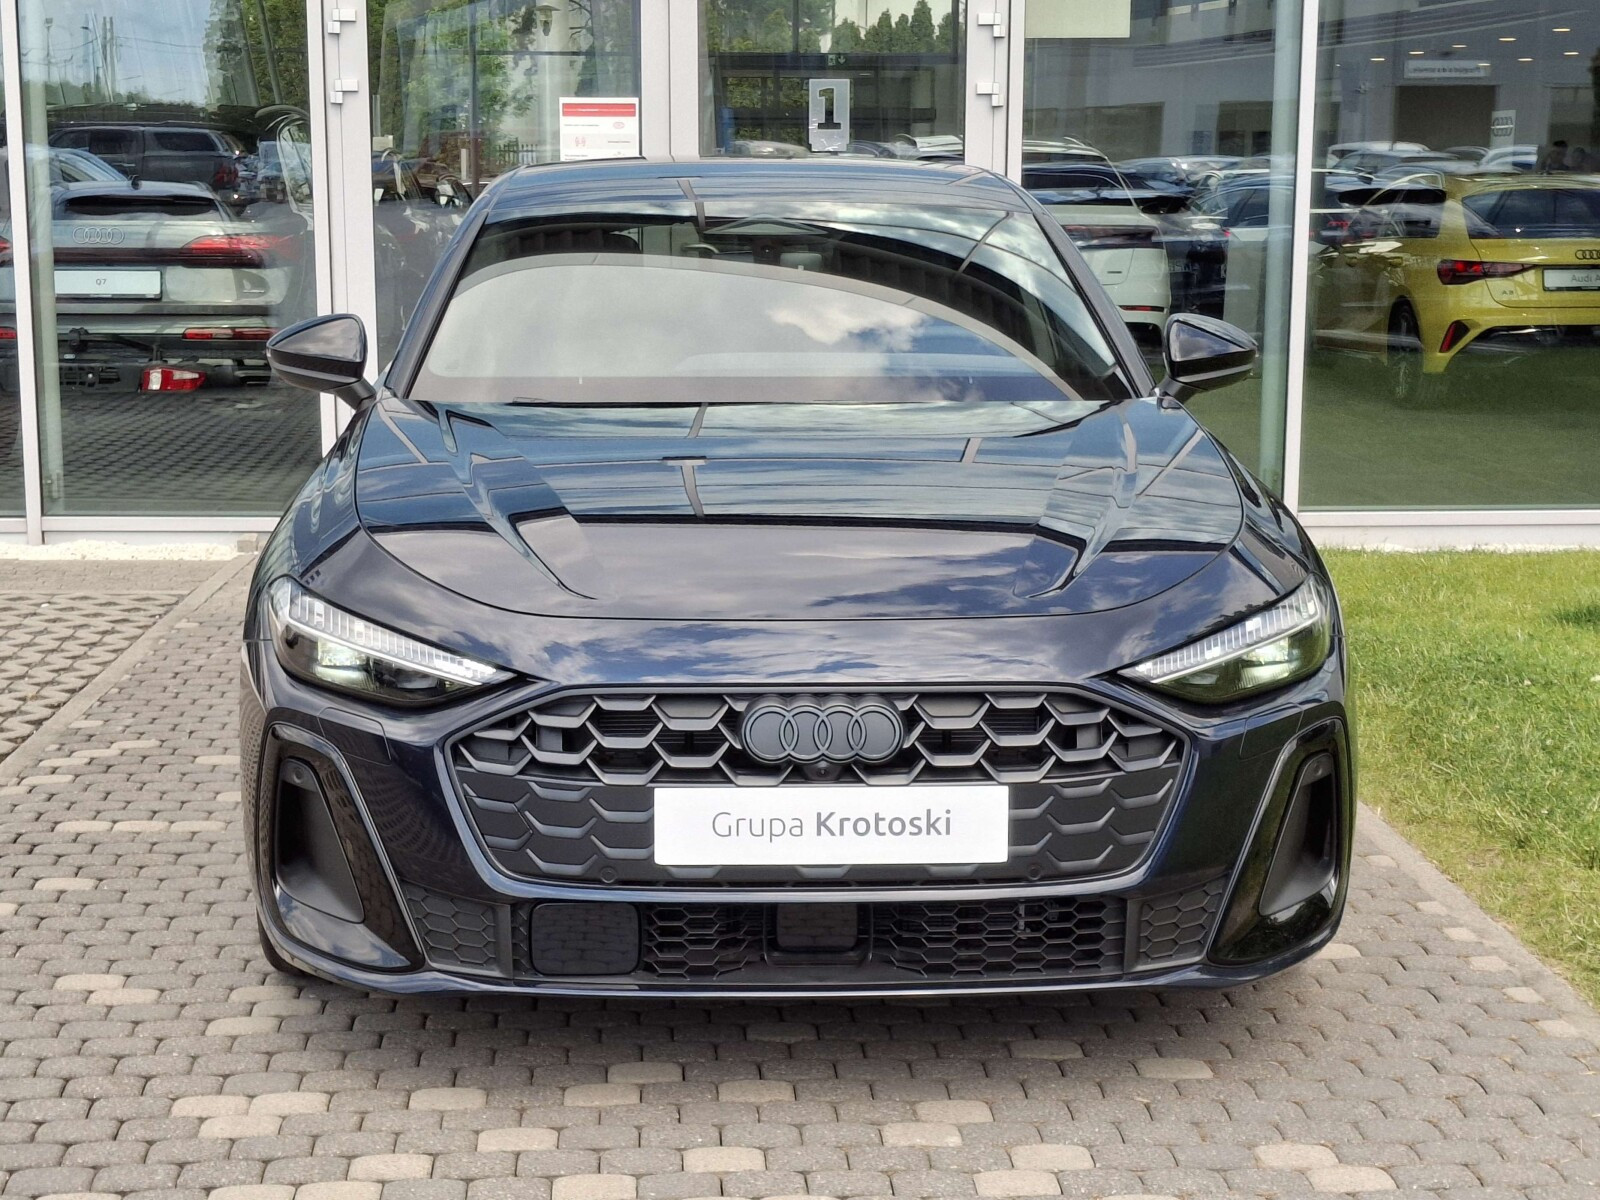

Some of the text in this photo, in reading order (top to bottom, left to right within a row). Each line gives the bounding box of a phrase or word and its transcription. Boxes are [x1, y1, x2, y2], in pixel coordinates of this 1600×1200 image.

[818, 87, 842, 130] 1
[95, 278, 107, 286] Q7
[1571, 274, 1592, 283] Audi
[711, 808, 952, 843] Grupa Krotoski
